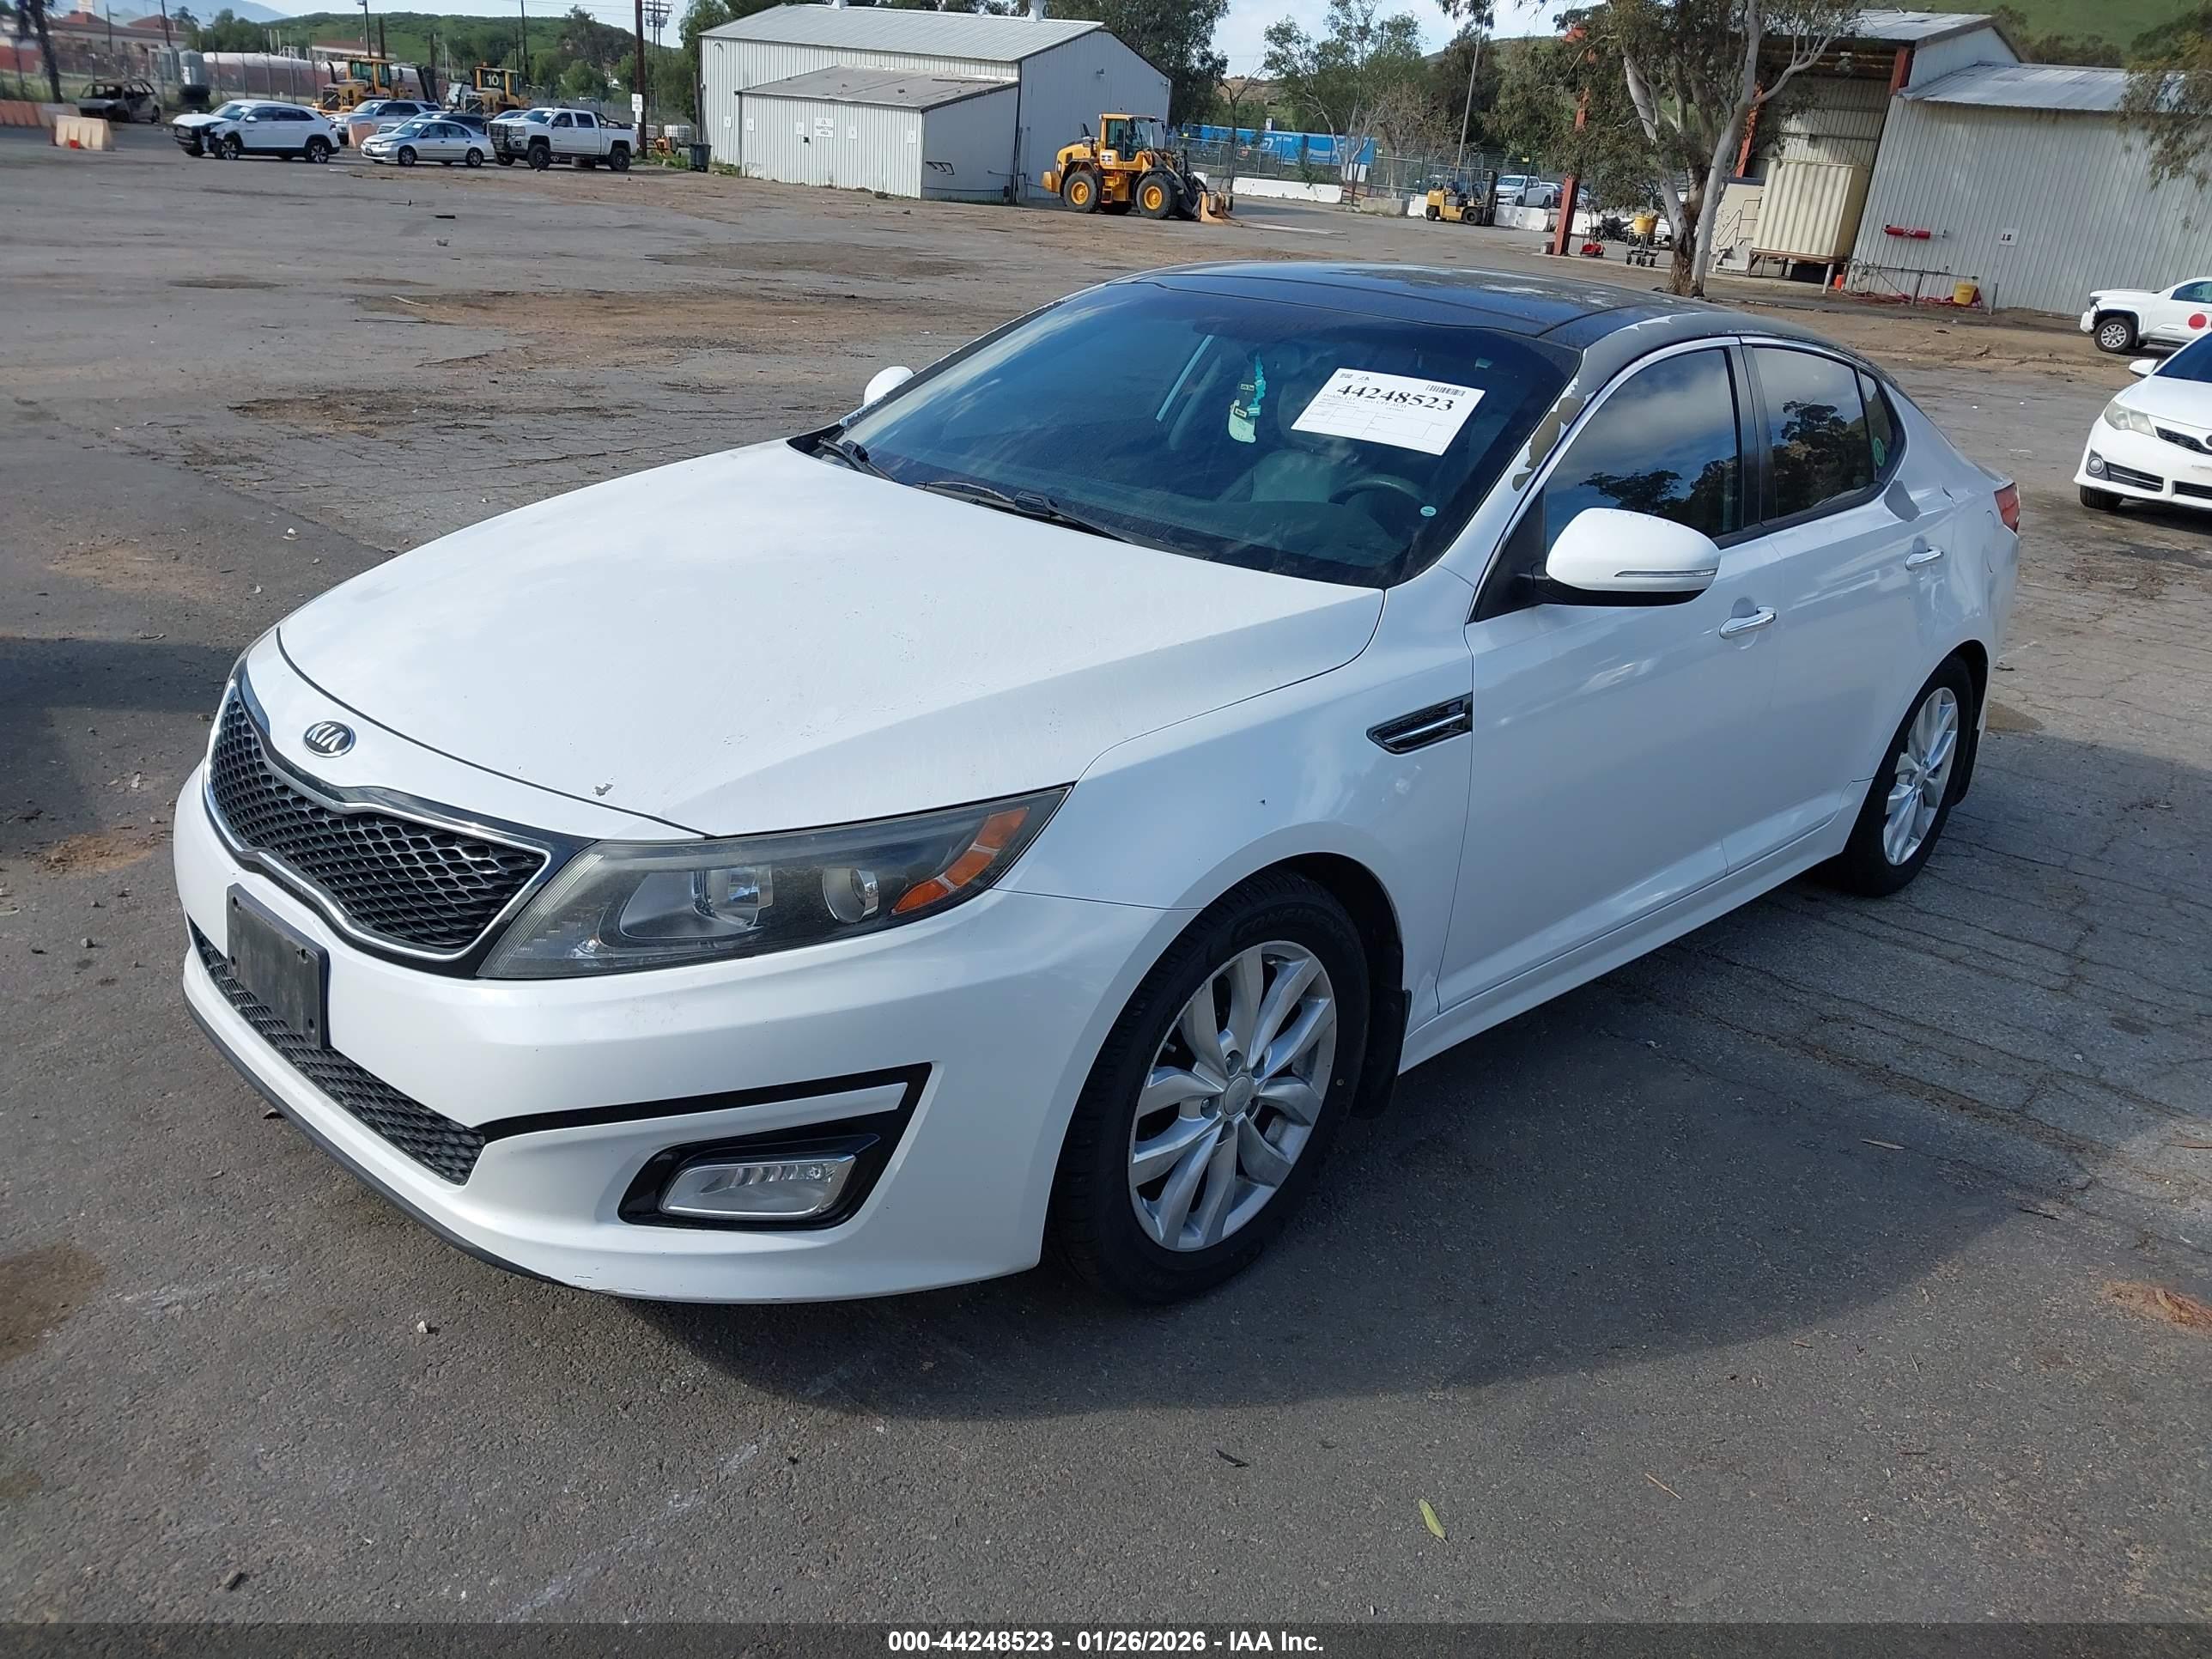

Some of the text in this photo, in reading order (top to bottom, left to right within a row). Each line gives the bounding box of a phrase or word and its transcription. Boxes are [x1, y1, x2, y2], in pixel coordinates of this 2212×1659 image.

[486, 74, 500, 87] 10
[1336, 384, 1455, 411] 44248523
[306, 721, 346, 752] KIA
